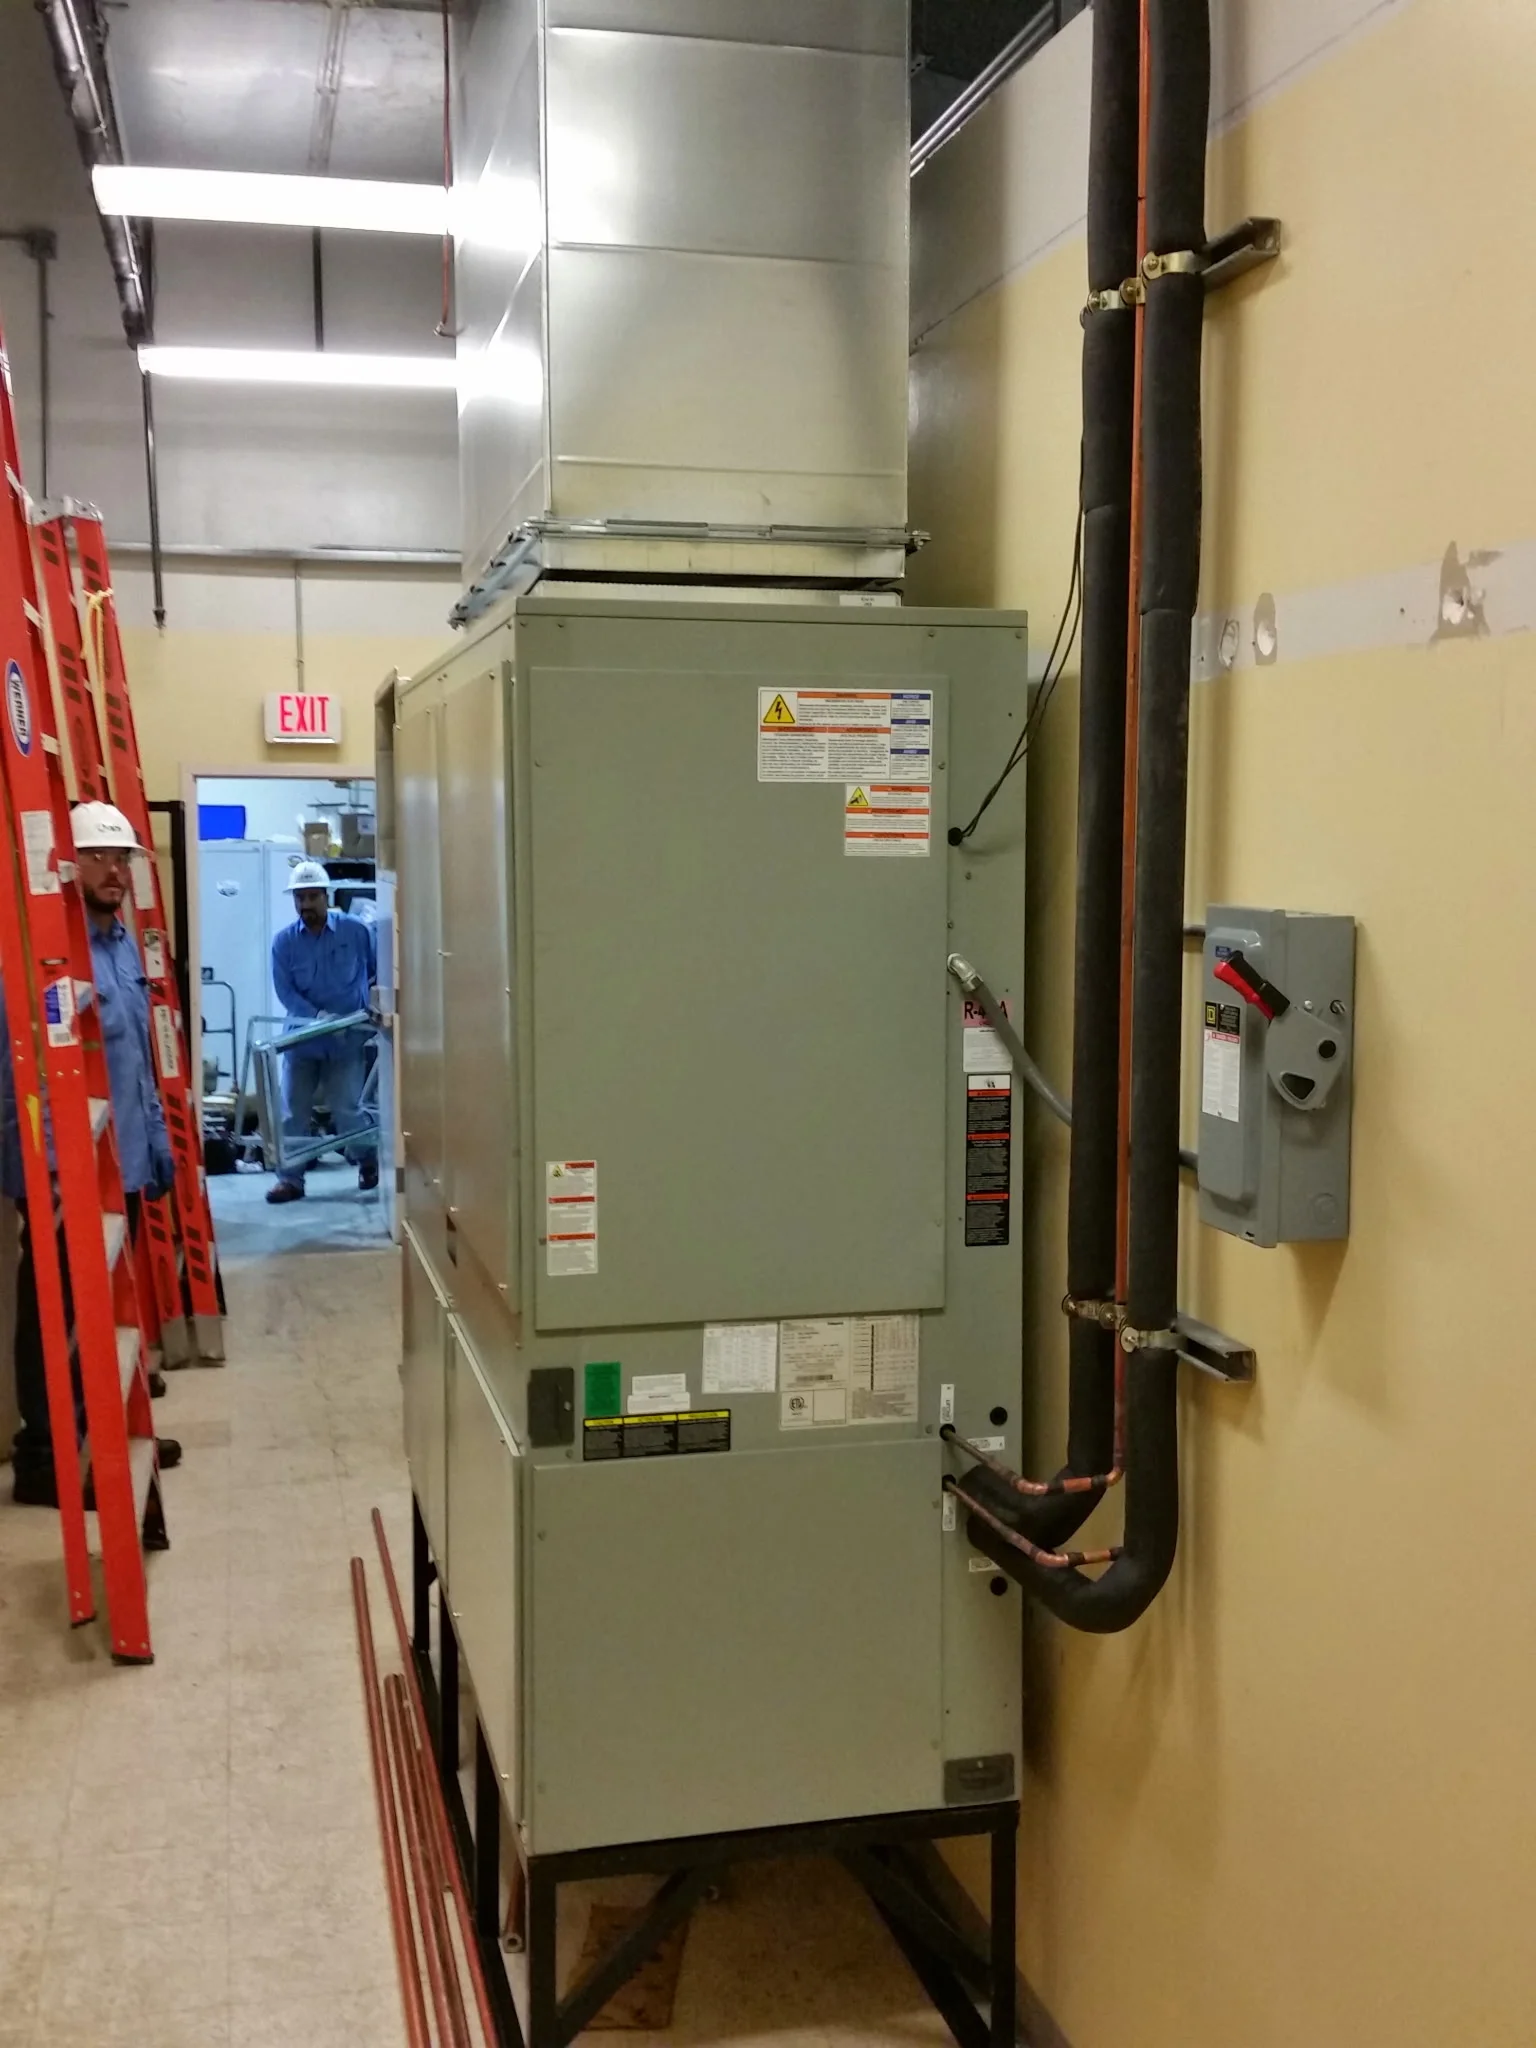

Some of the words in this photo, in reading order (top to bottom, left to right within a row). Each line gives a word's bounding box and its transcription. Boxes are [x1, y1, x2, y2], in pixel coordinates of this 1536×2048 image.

[11, 679, 28, 737] WERNER
[280, 695, 329, 732] EXIT
[964, 1000, 1008, 1020] R-4A
